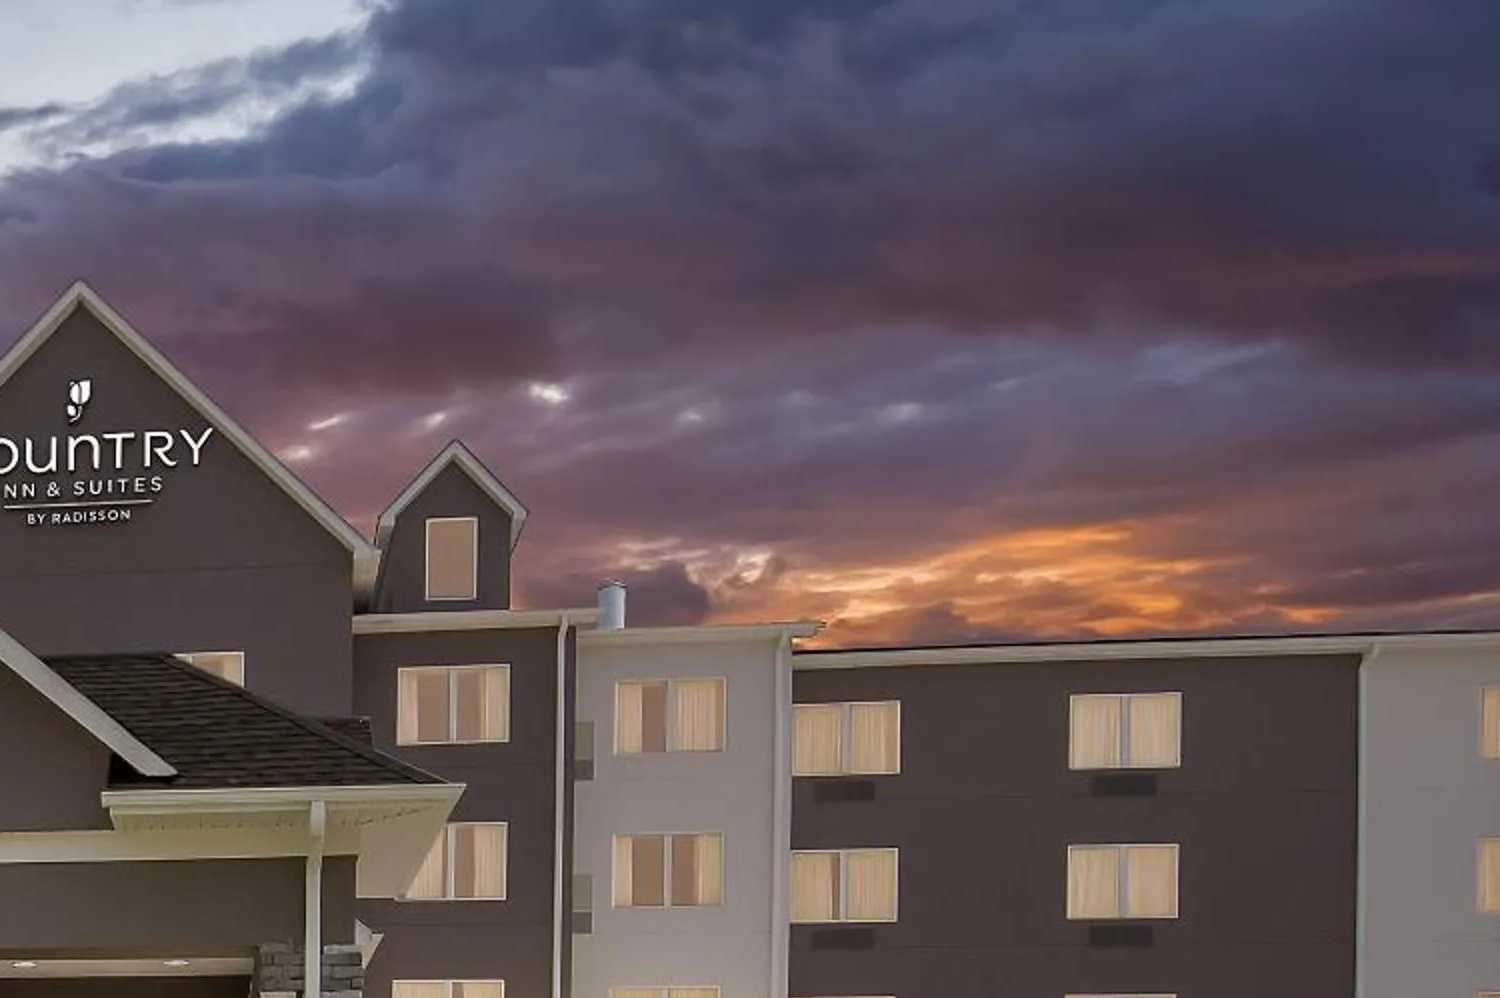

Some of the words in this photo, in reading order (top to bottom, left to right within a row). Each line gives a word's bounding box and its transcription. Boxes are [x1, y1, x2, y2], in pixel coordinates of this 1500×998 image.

[46, 481, 61, 497] &
[73, 476, 163, 496] SUITES
[27, 513, 46, 525] BY
[51, 509, 131, 524] RADISSON
